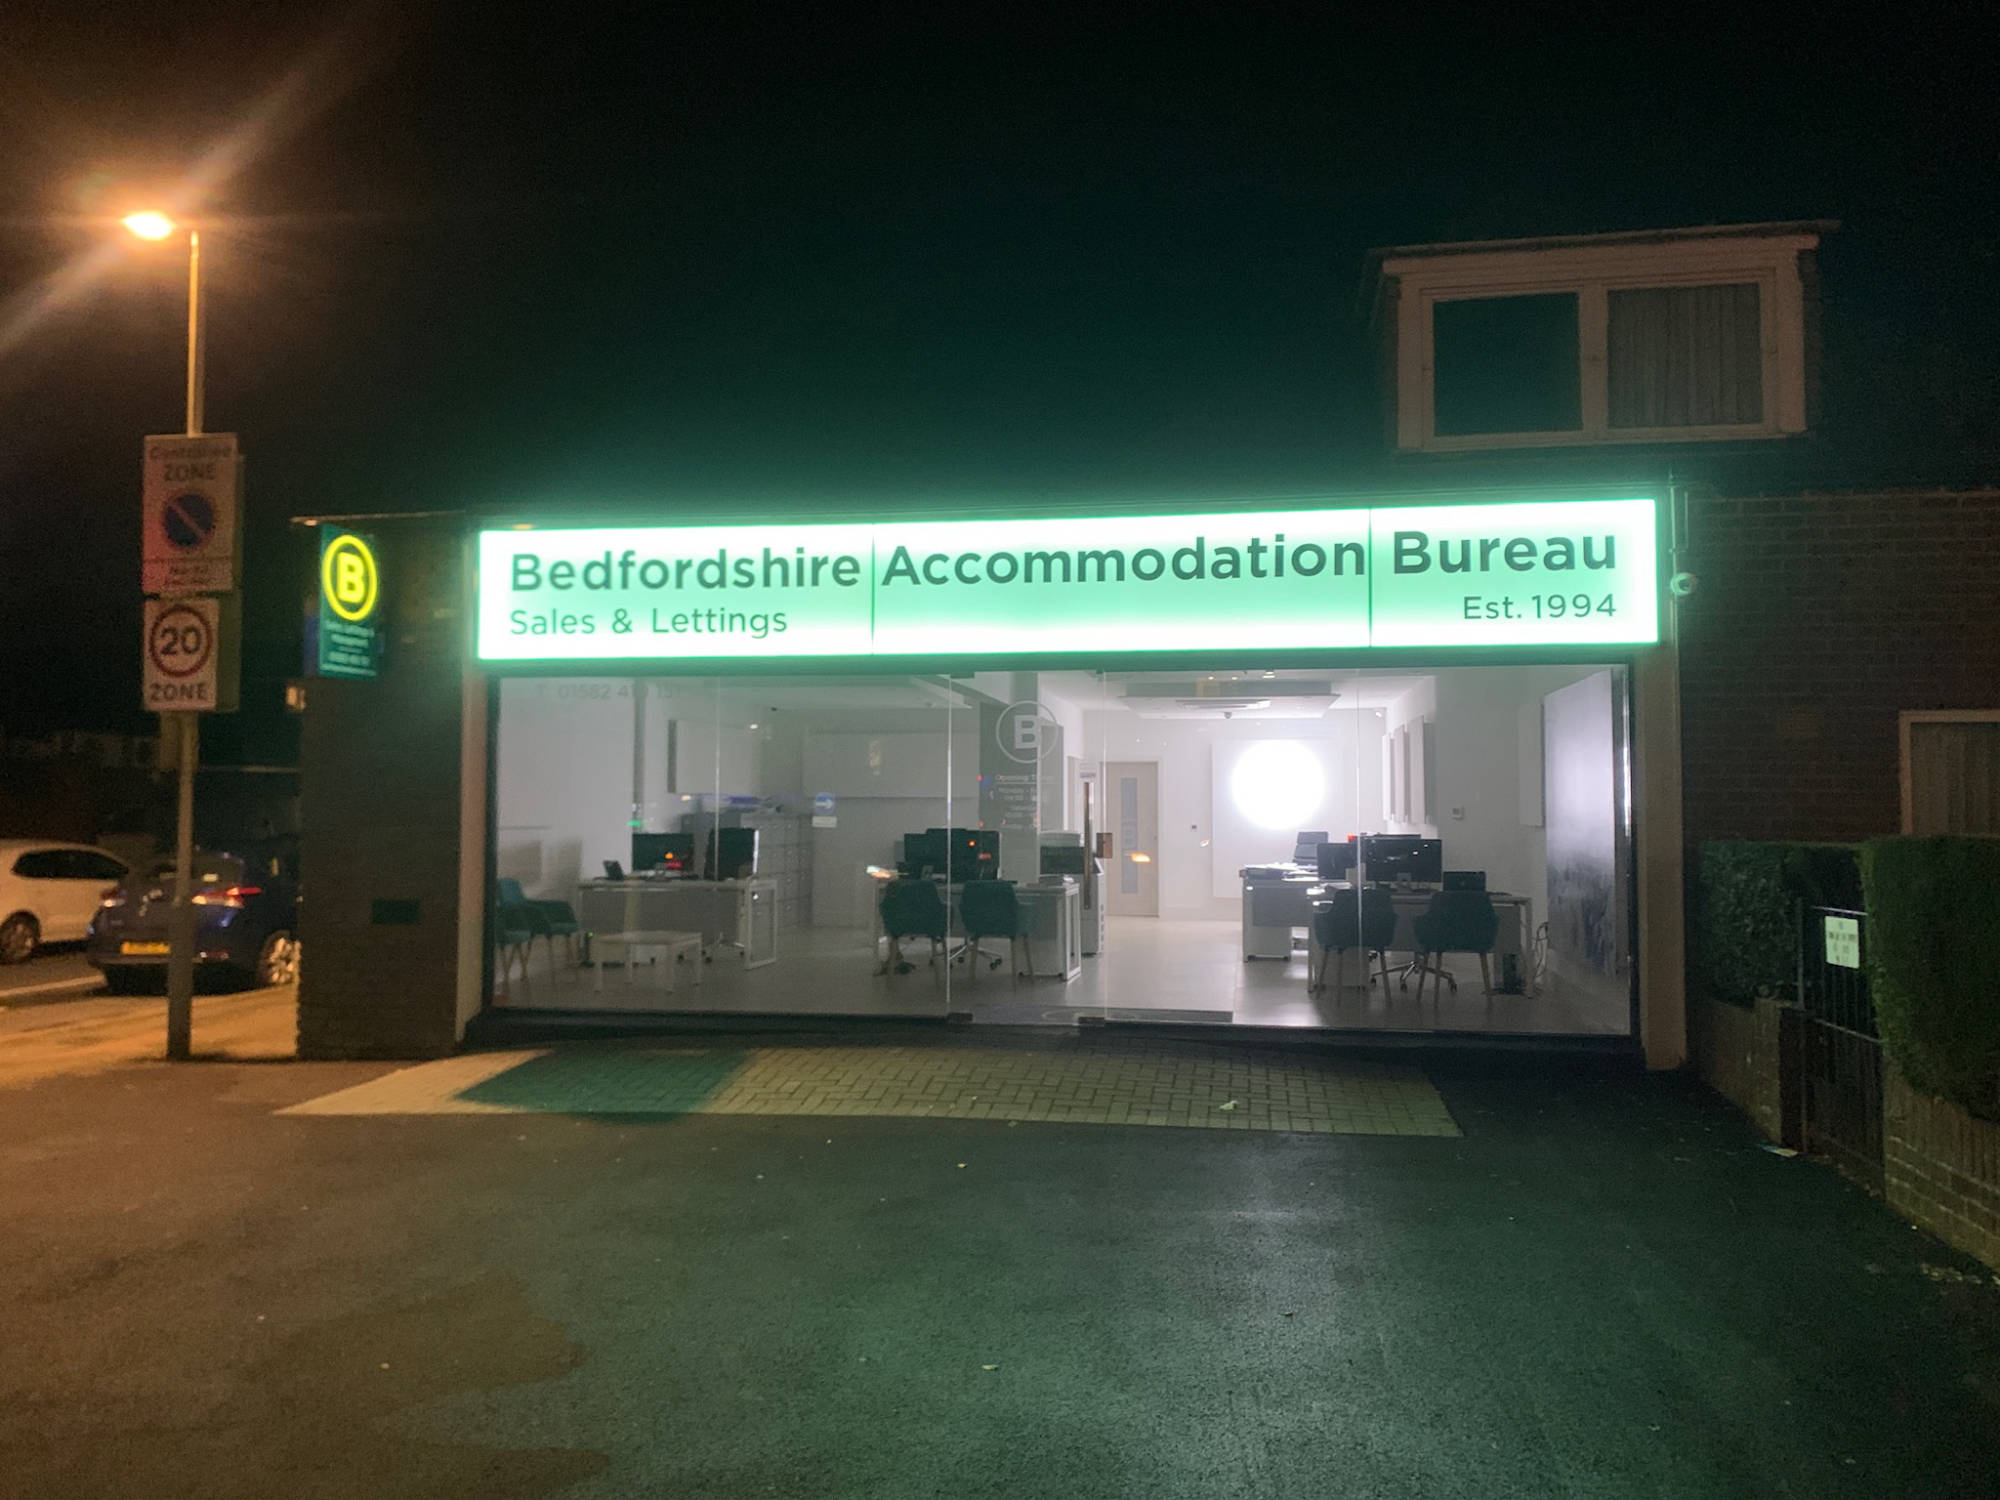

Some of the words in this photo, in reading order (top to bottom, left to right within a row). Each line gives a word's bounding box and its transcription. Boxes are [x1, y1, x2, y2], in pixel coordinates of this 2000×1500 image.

[336, 551, 366, 604] B
[511, 548, 861, 592] Bedfordshire
[881, 533, 1366, 587] Accommodation
[1393, 530, 1617, 575] Bureau
[510, 607, 596, 636] Sales
[611, 608, 634, 636] &
[651, 605, 789, 639] Lettings
[160, 625, 201, 655] 20
[150, 683, 207, 700] ZONE
[1014, 714, 1041, 749] B
